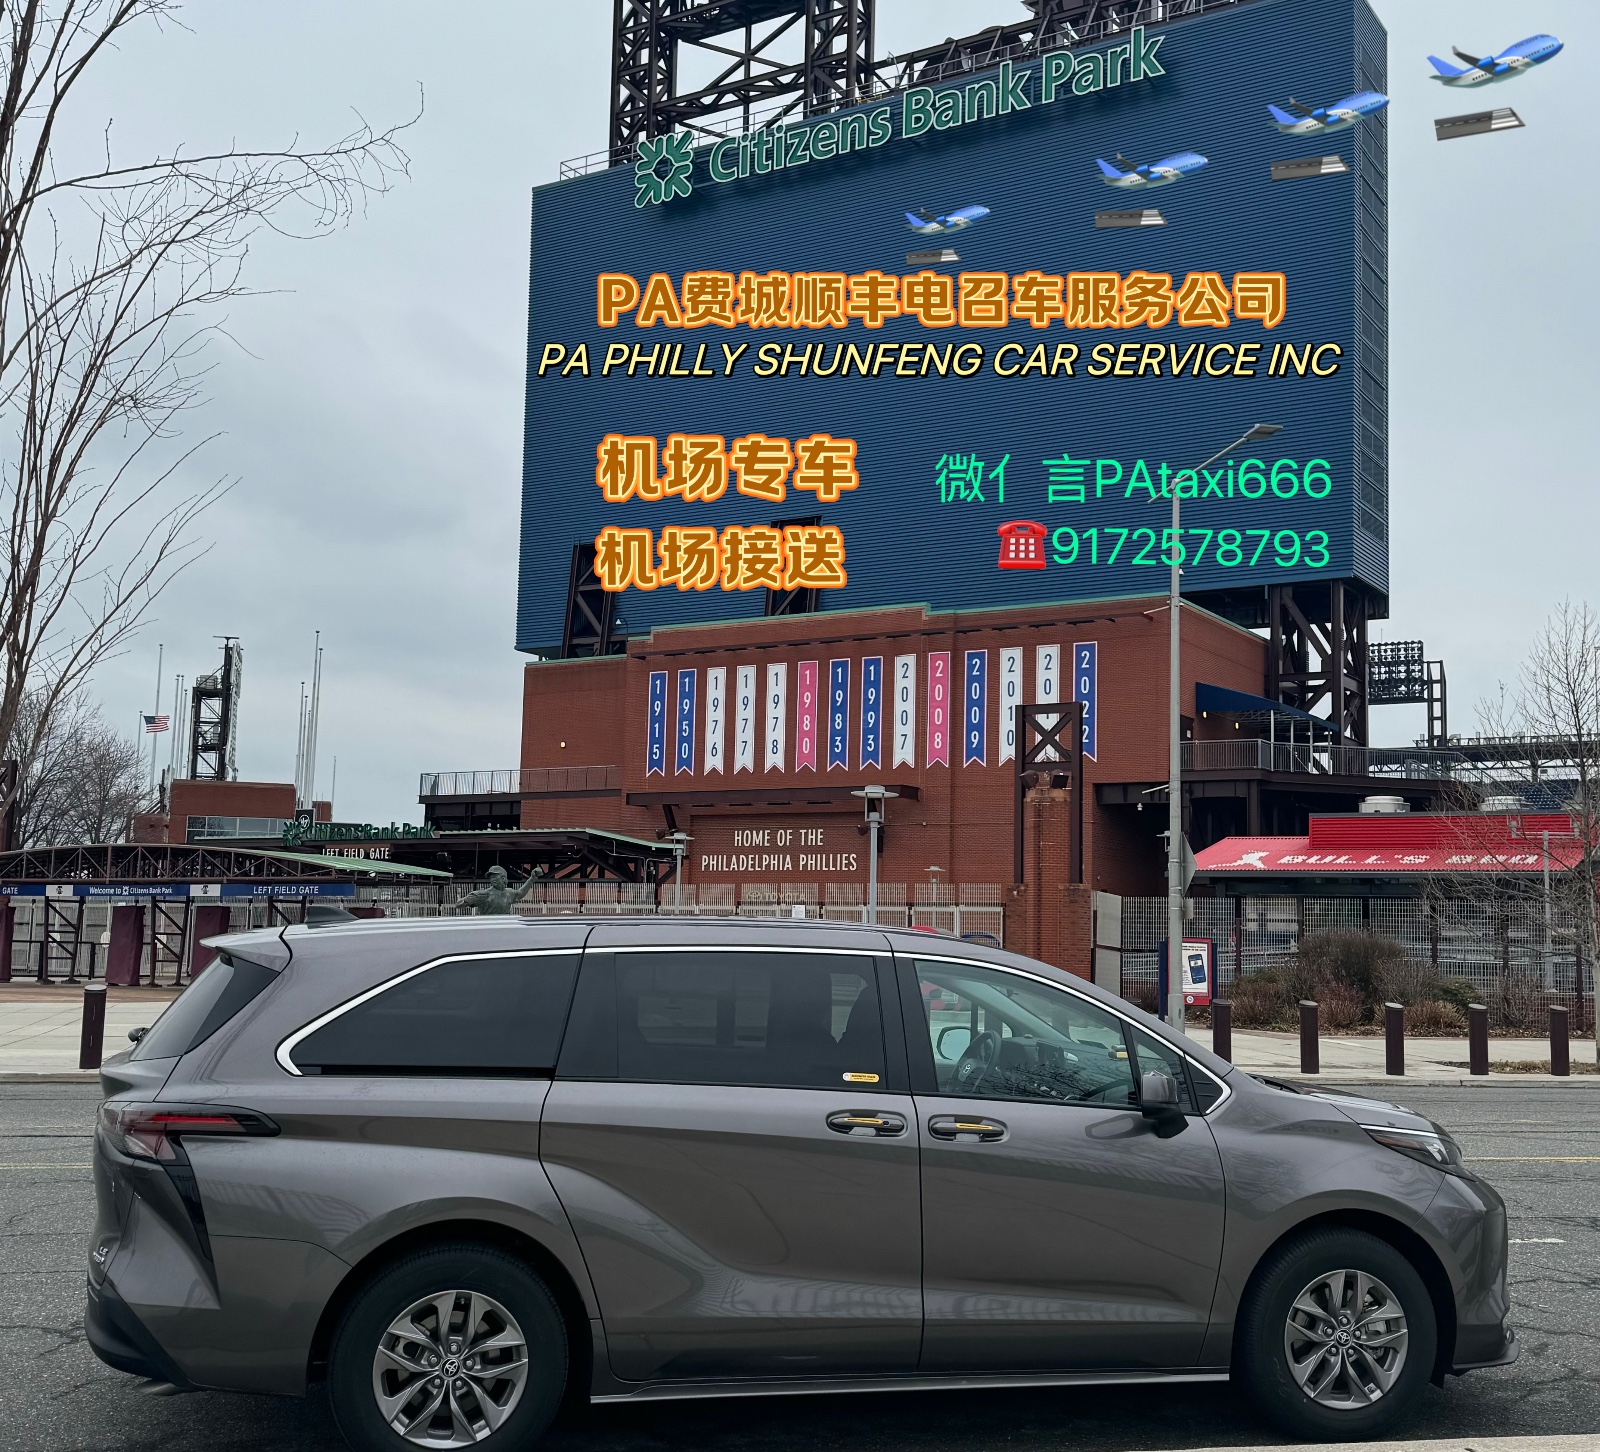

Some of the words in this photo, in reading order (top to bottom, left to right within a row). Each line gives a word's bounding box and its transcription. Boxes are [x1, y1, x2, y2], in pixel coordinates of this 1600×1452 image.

[709, 105, 892, 183] Citizens
[902, 62, 1031, 139] Bank
[1042, 26, 1166, 103] Park
[652, 679, 662, 760] 1915
[681, 677, 690, 759] 1950
[711, 675, 719, 757] 1976
[741, 674, 749, 756] 1977
[771, 671, 780, 755] 1978
[802, 669, 811, 754] 1980
[834, 667, 843, 753] 1983
[866, 664, 876, 752] 1993
[900, 662, 909, 750] 2007
[934, 660, 943, 749] 2008
[971, 658, 980, 748] 2009
[1006, 656, 1016, 746] 2010
[1081, 650, 1090, 743] 2022
[305, 824, 360, 840] Citizens
[362, 822, 400, 839] Bank
[402, 821, 436, 839] Park
[344, 848, 364, 859] FIELD
[369, 847, 390, 860] GATE
[701, 855, 792, 872] PHILADELPHIA
[799, 854, 857, 871] PHILLIES
[734, 830, 770, 847] HOME
[777, 829, 793, 846] OF
[800, 829, 824, 846] THE
[2, 886, 18, 895] GATE
[89, 886, 114, 895] Welcome
[115, 887, 121, 895] to
[253, 885, 272, 895] LEFT
[275, 885, 297, 895] FIELD
[299, 885, 319, 895] GATE
